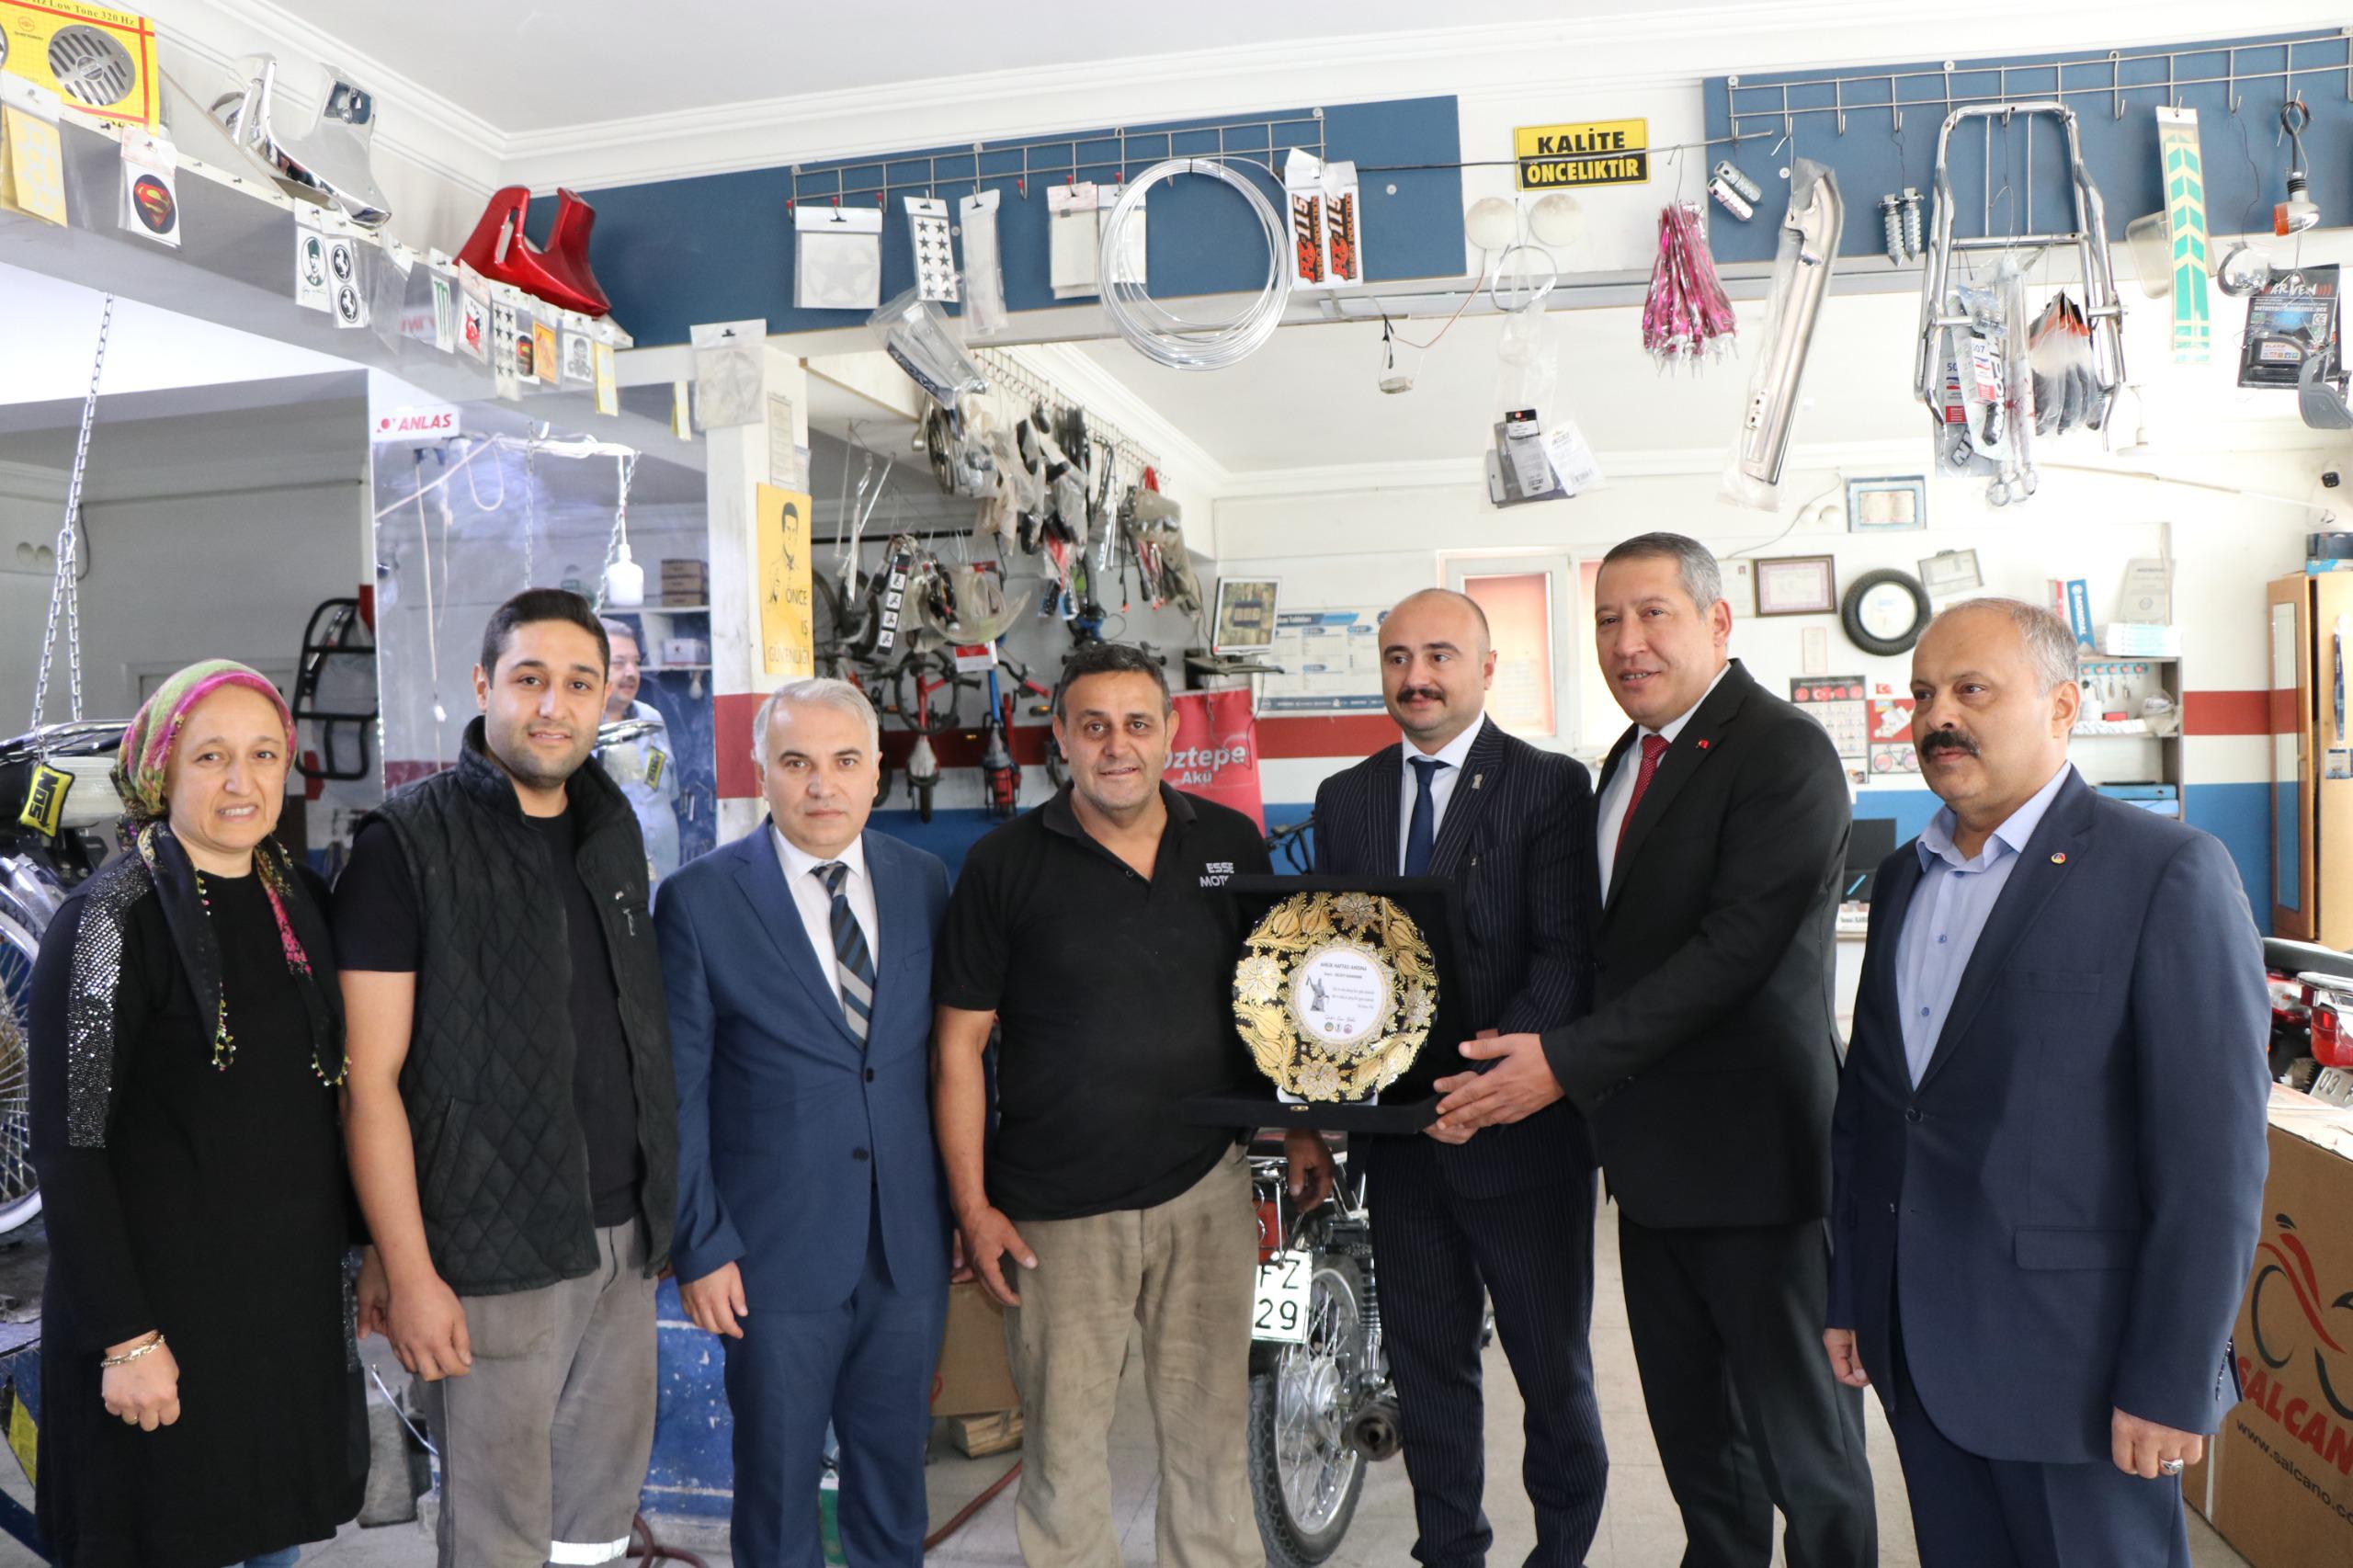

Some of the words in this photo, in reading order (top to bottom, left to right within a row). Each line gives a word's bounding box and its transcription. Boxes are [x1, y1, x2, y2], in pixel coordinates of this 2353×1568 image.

[50, 0, 72, 10] Low
[75, 5, 98, 17] Tone
[101, 10, 119, 22] 320
[120, 13, 135, 26] Hz
[1538, 128, 1625, 154] KALİTE
[398, 413, 452, 432] ANLAS
[2074, 595, 2087, 636] MONDIAL
[1182, 770, 1213, 785] Akü
[28, 770, 60, 829] NOS
[1206, 861, 1235, 874] ESSE
[1199, 874, 1230, 888] MOT
[2318, 1070, 2341, 1095] 03
[1255, 1298, 1298, 1331] 29
